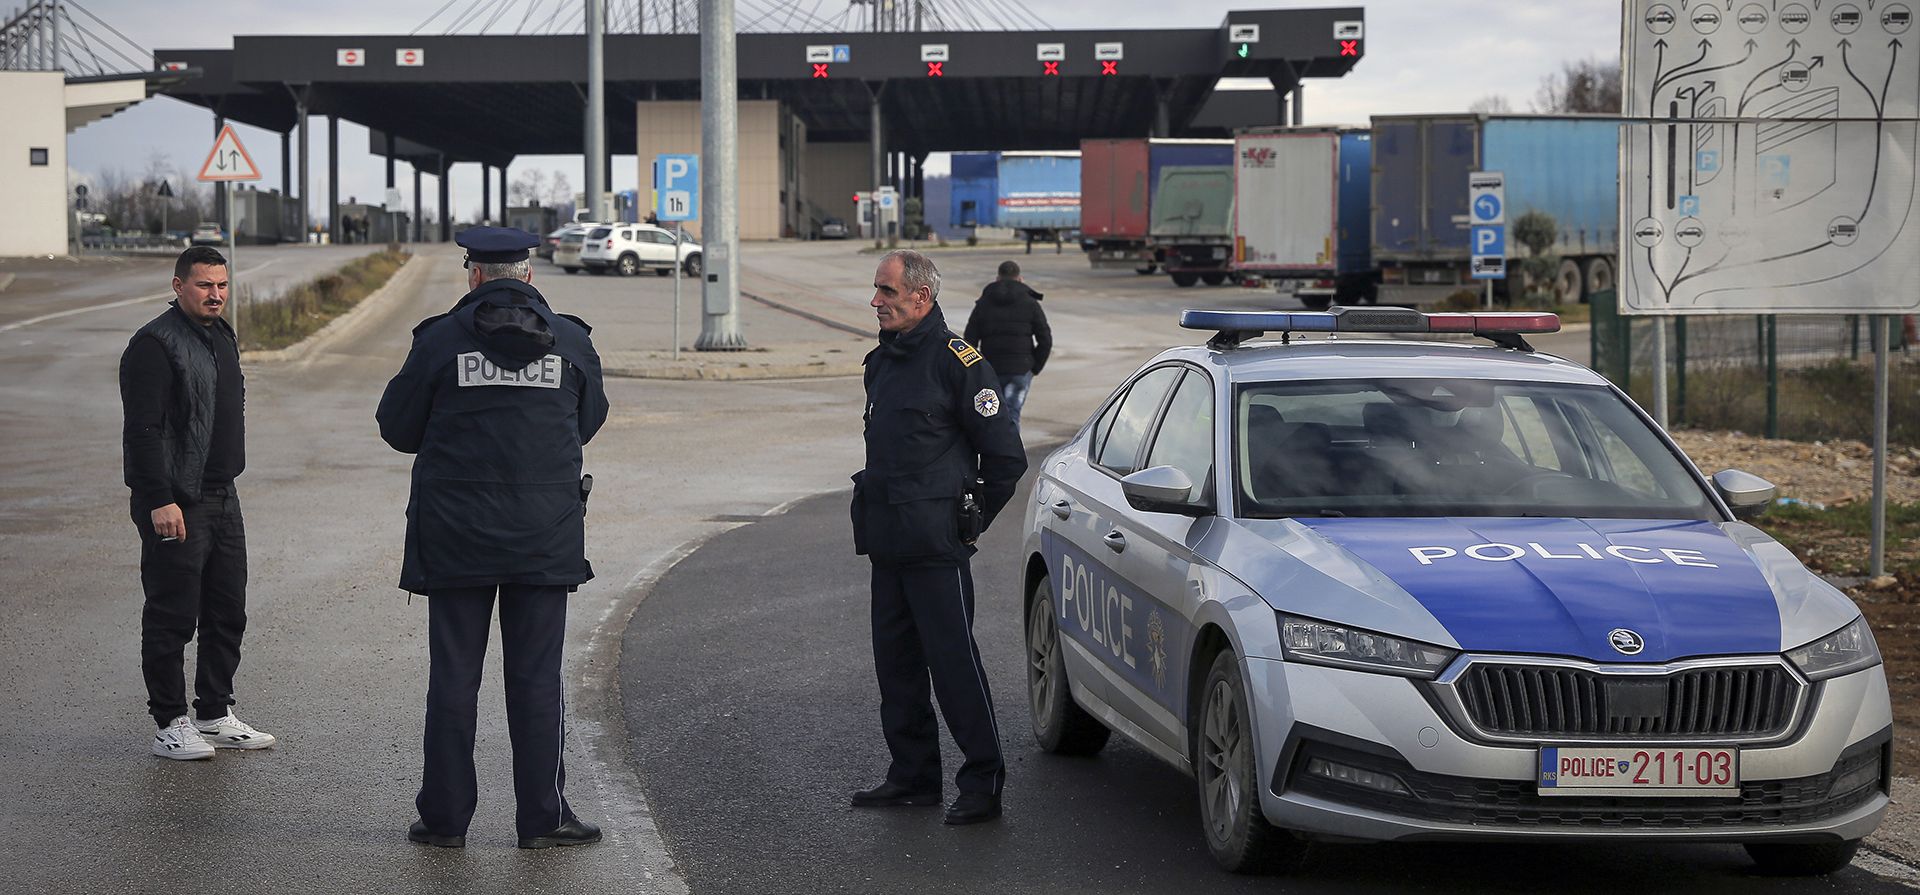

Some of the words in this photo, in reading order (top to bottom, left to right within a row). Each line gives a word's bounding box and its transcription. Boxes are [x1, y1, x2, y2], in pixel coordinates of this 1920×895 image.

[666, 159, 689, 189] P
[1703, 154, 1713, 169] P
[670, 197, 683, 212] 1h
[1684, 200, 1695, 215] P
[1478, 229, 1497, 255] P
[1408, 542, 1720, 569] POLICE
[1062, 554, 1136, 669] POLICE
[1543, 772, 1557, 781] RKS
[1560, 757, 1615, 777] POLICE
[1632, 750, 1732, 785] 211-03
